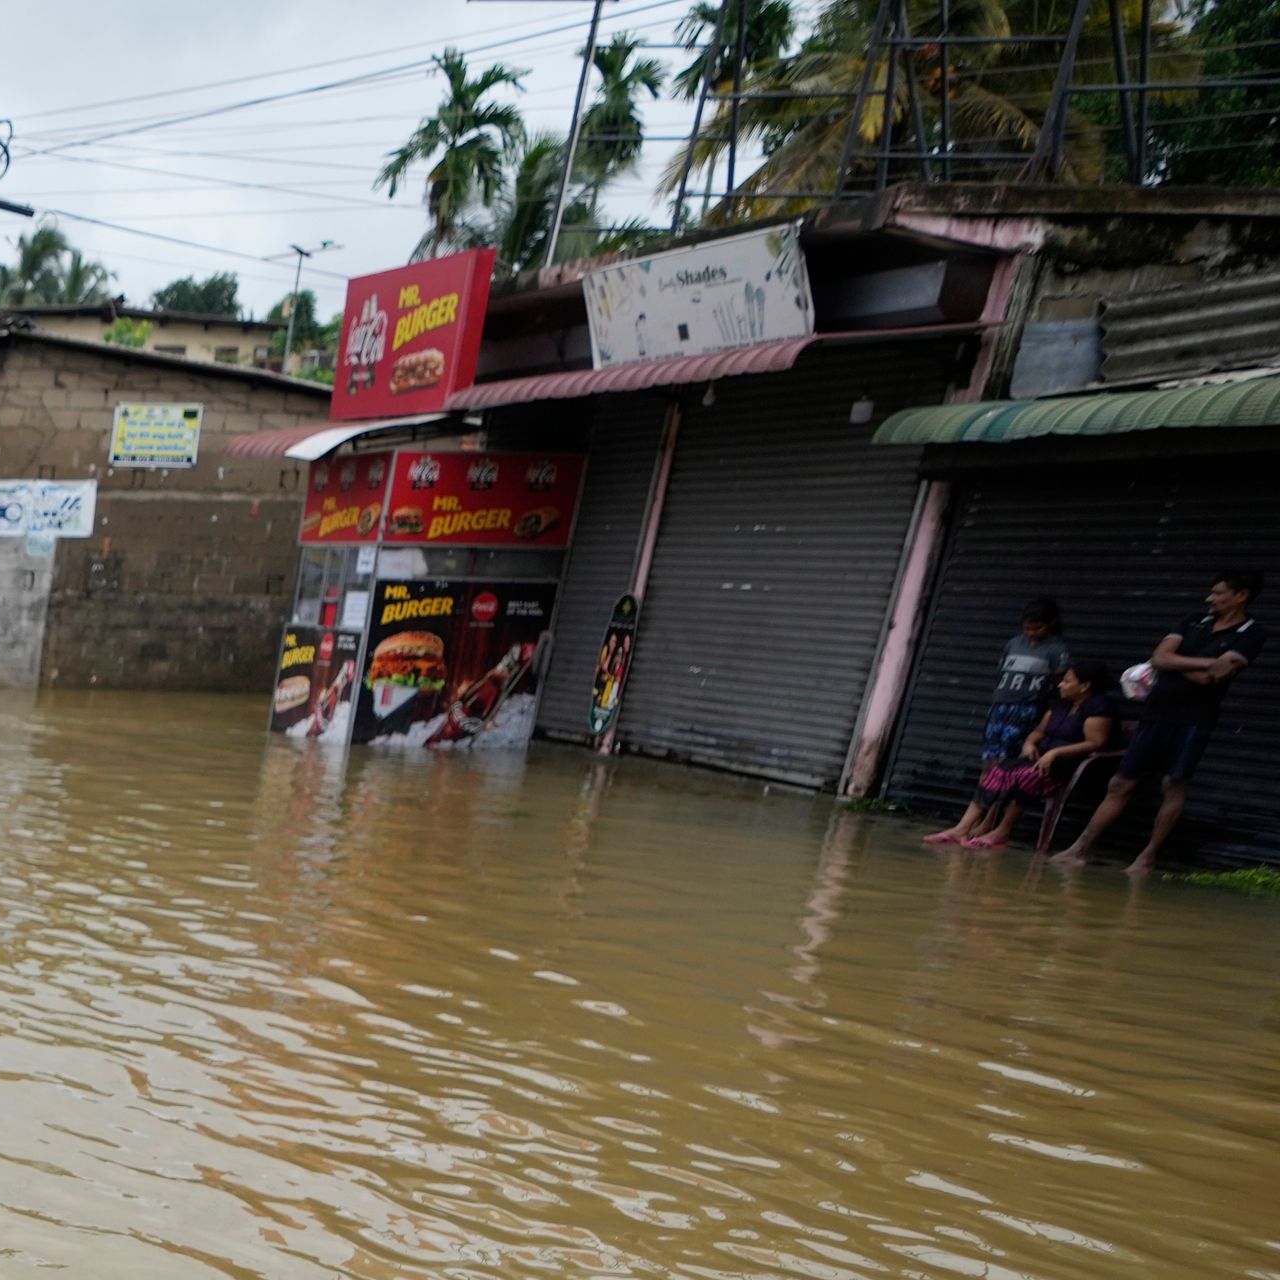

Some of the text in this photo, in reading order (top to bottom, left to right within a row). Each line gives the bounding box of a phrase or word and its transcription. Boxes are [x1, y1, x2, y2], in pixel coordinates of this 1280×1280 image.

[675, 264, 728, 287] Shades
[398, 284, 422, 310] MR.
[392, 293, 458, 350] BURGER
[432, 496, 462, 512] MR.
[427, 509, 511, 539] BURGER
[385, 585, 411, 600] MR.
[381, 597, 453, 625] BURGER
[281, 646, 315, 668] BURGER
